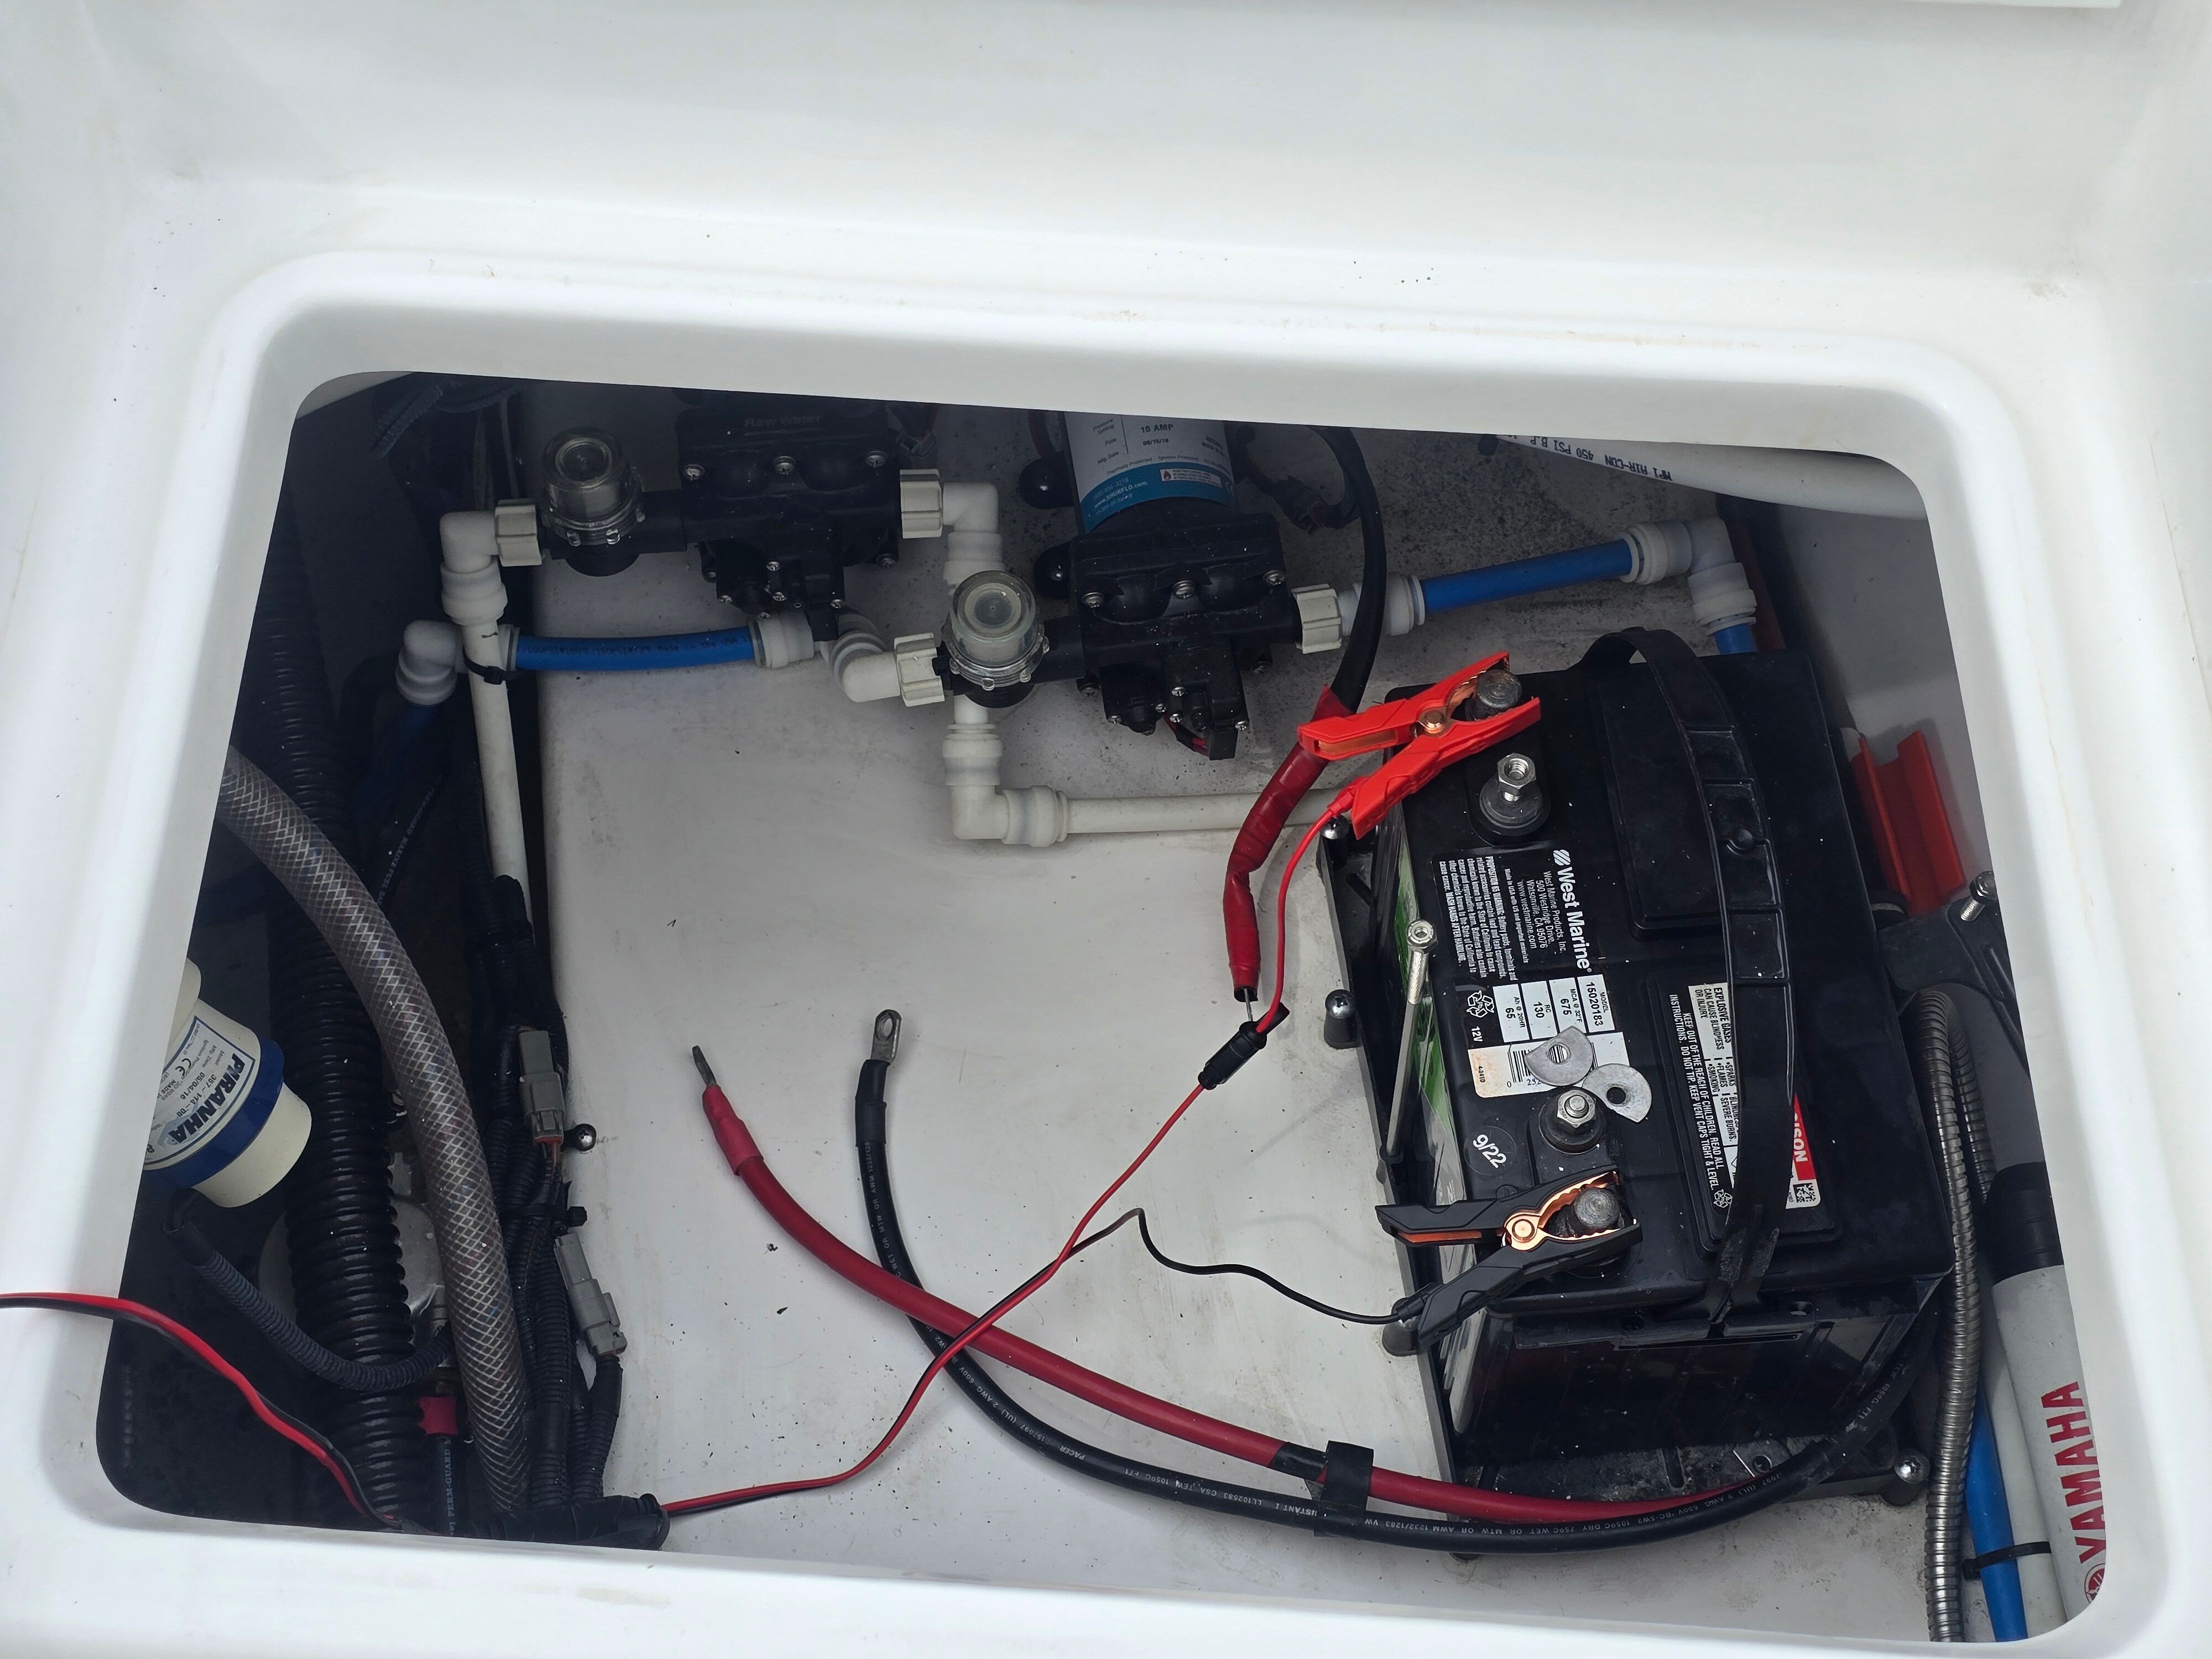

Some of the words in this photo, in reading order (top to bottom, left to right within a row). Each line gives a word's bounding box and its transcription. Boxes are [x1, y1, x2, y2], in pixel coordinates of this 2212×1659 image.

[1554, 440, 1571, 455] PSI
[1576, 448, 1593, 461] 450
[1604, 455, 1647, 475] AIR-CON
[1535, 880, 1545, 891] 500
[1543, 871, 1554, 886] West
[1556, 868, 1580, 908] West
[1525, 880, 1541, 916] Watsonville,
[1546, 888, 1558, 909] Marine
[1516, 881, 1537, 948] www.westmarine.com
[1537, 894, 1552, 924] Westridge
[1533, 917, 1543, 926] CA
[1550, 910, 1565, 939] Products,
[1536, 928, 1548, 948] 95076
[1545, 925, 1557, 943] Drive.
[1557, 941, 1568, 952] Inc.
[1569, 988, 1578, 1001] MCA
[1599, 992, 1609, 1013] MODEL
[1703, 989, 1713, 999] CAN
[1532, 1002, 1545, 1018] 130
[1559, 998, 1571, 1015] 675
[1585, 982, 1603, 1026] 15020183
[1706, 1001, 1717, 1018] CAUSE
[1713, 987, 1729, 1021] EXPLOSIVE
[1505, 1008, 1515, 1019] 65
[1517, 1013, 1525, 1027] 20HR
[1668, 994, 1687, 1042] INSTRUCTIONS.
[1683, 1013, 1693, 1028] KEEP
[1470, 1025, 1483, 1043] 12V
[1686, 1030, 1697, 1041] OUT
[1679, 1046, 1690, 1055] DO
[1689, 1045, 1699, 1054] OF
[1682, 1057, 1693, 1070] NOT
[1691, 1055, 1702, 1065] THE
[1686, 1072, 1696, 1082] TIP.
[1694, 1068, 1707, 1088] REACH
[1707, 1067, 1720, 1092] SMOKING
[1716, 1066, 1728, 1087] FLAMES
[1725, 1066, 1736, 1086] SPARKS
[168, 1053, 245, 1143] PIRANHA
[1688, 1085, 1699, 1100] KEEP
[1692, 1103, 1703, 1119] VENT
[1720, 1098, 1732, 1118] SEVERE
[1701, 1101, 1717, 1134] CHILDREN.
[1696, 1121, 1708, 1138] CAPS
[1725, 1120, 1737, 1140] BURNS.
[1470, 1129, 1509, 1172] 9/22
[1700, 1140, 1713, 1159] TIGHT
[1709, 1138, 1721, 1155] READ
[1713, 1156, 1724, 1168] ALL
[869, 1175, 877, 1193] AWM
[873, 1198, 880, 1210] OR
[876, 1215, 885, 1234] MTW
[881, 1238, 890, 1249] OR
[886, 1253, 902, 1272] WET
[958, 1366, 975, 1384] 600V
[977, 1385, 994, 1402] AWG
[1000, 1408, 1018, 1424] (UL)
[1060, 1445, 1086, 1460] PACER
[2041, 1381, 2106, 1564] YAMAHA
[1223, 1493, 1262, 1506] LL102583
[1678, 1505, 1699, 1515] 600V
[1385, 1521, 1428, 1531] 1232/1283
